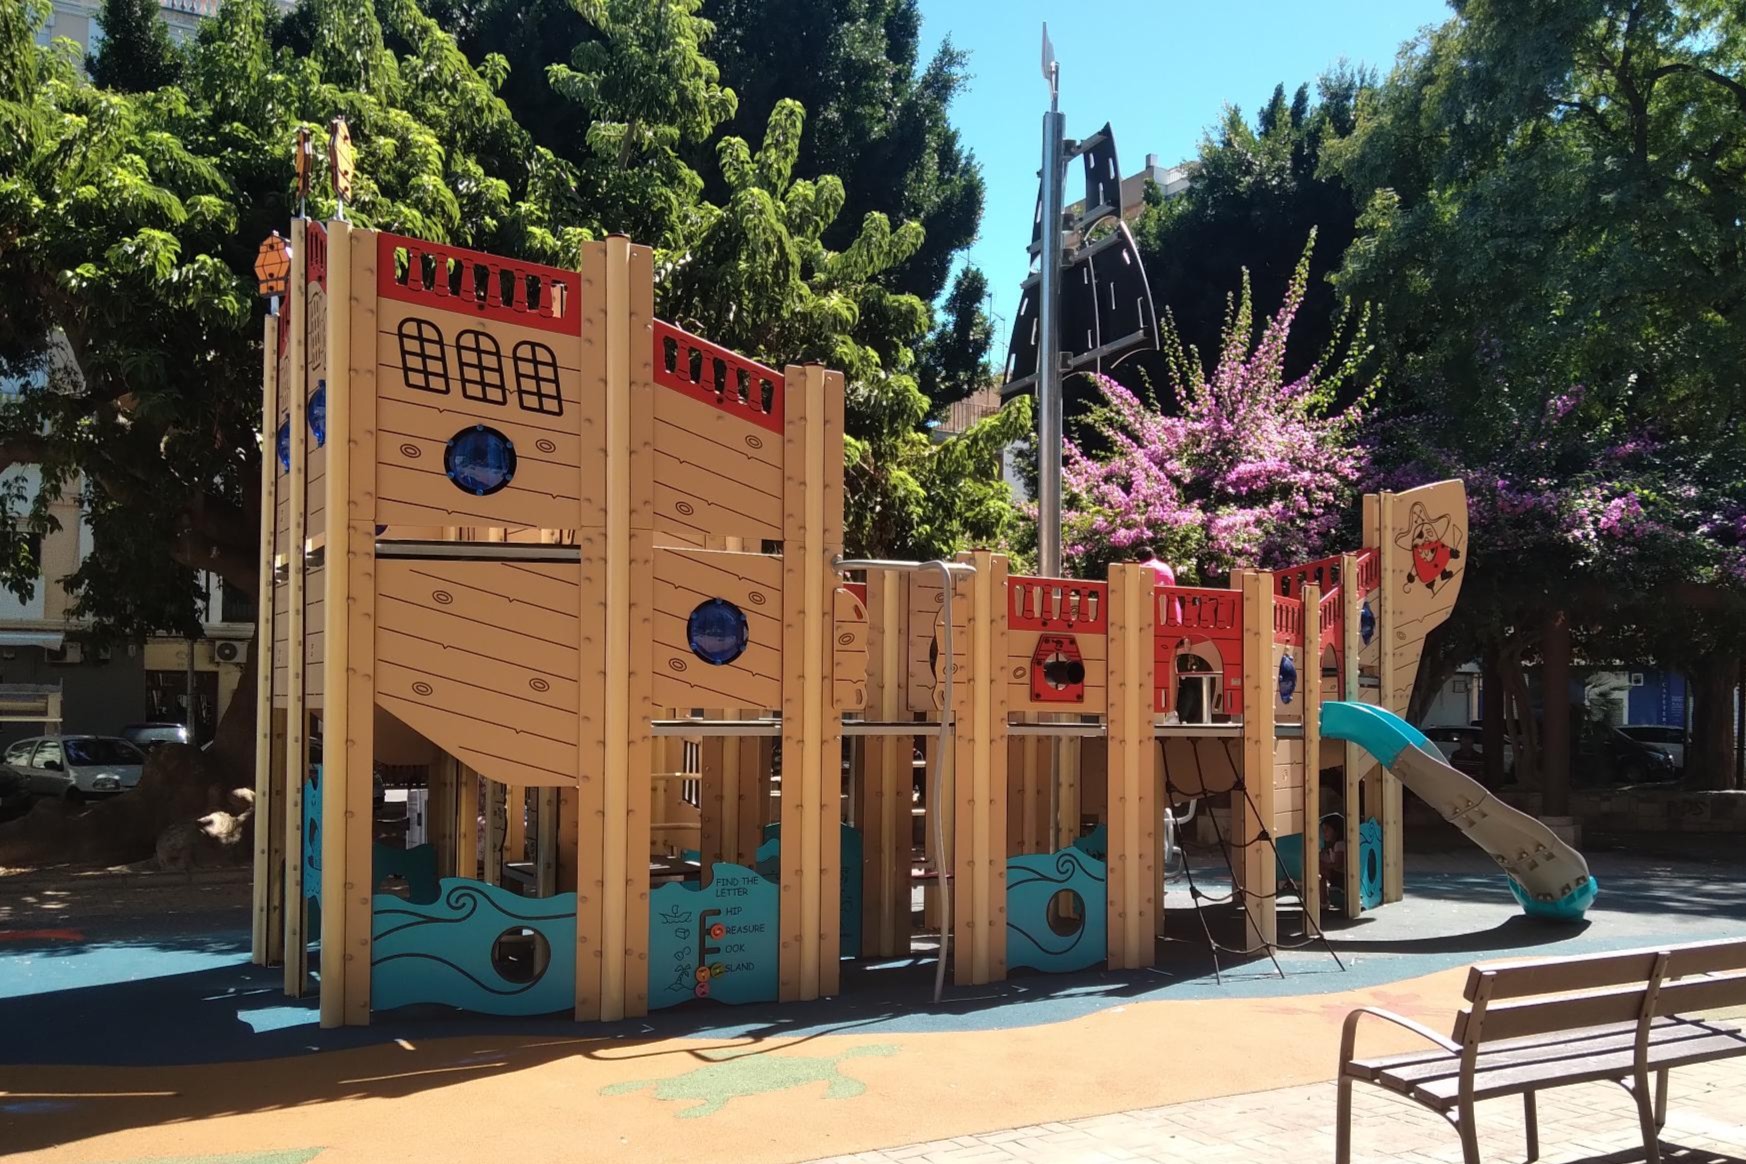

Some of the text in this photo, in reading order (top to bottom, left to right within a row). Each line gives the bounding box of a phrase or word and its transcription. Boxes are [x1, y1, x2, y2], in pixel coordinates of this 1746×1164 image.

[716, 876, 759, 887] FIND THE
[716, 887, 749, 898] LETTER
[726, 906, 743, 916] HIP
[725, 923, 766, 935] REASURE
[725, 943, 746, 953] OOK
